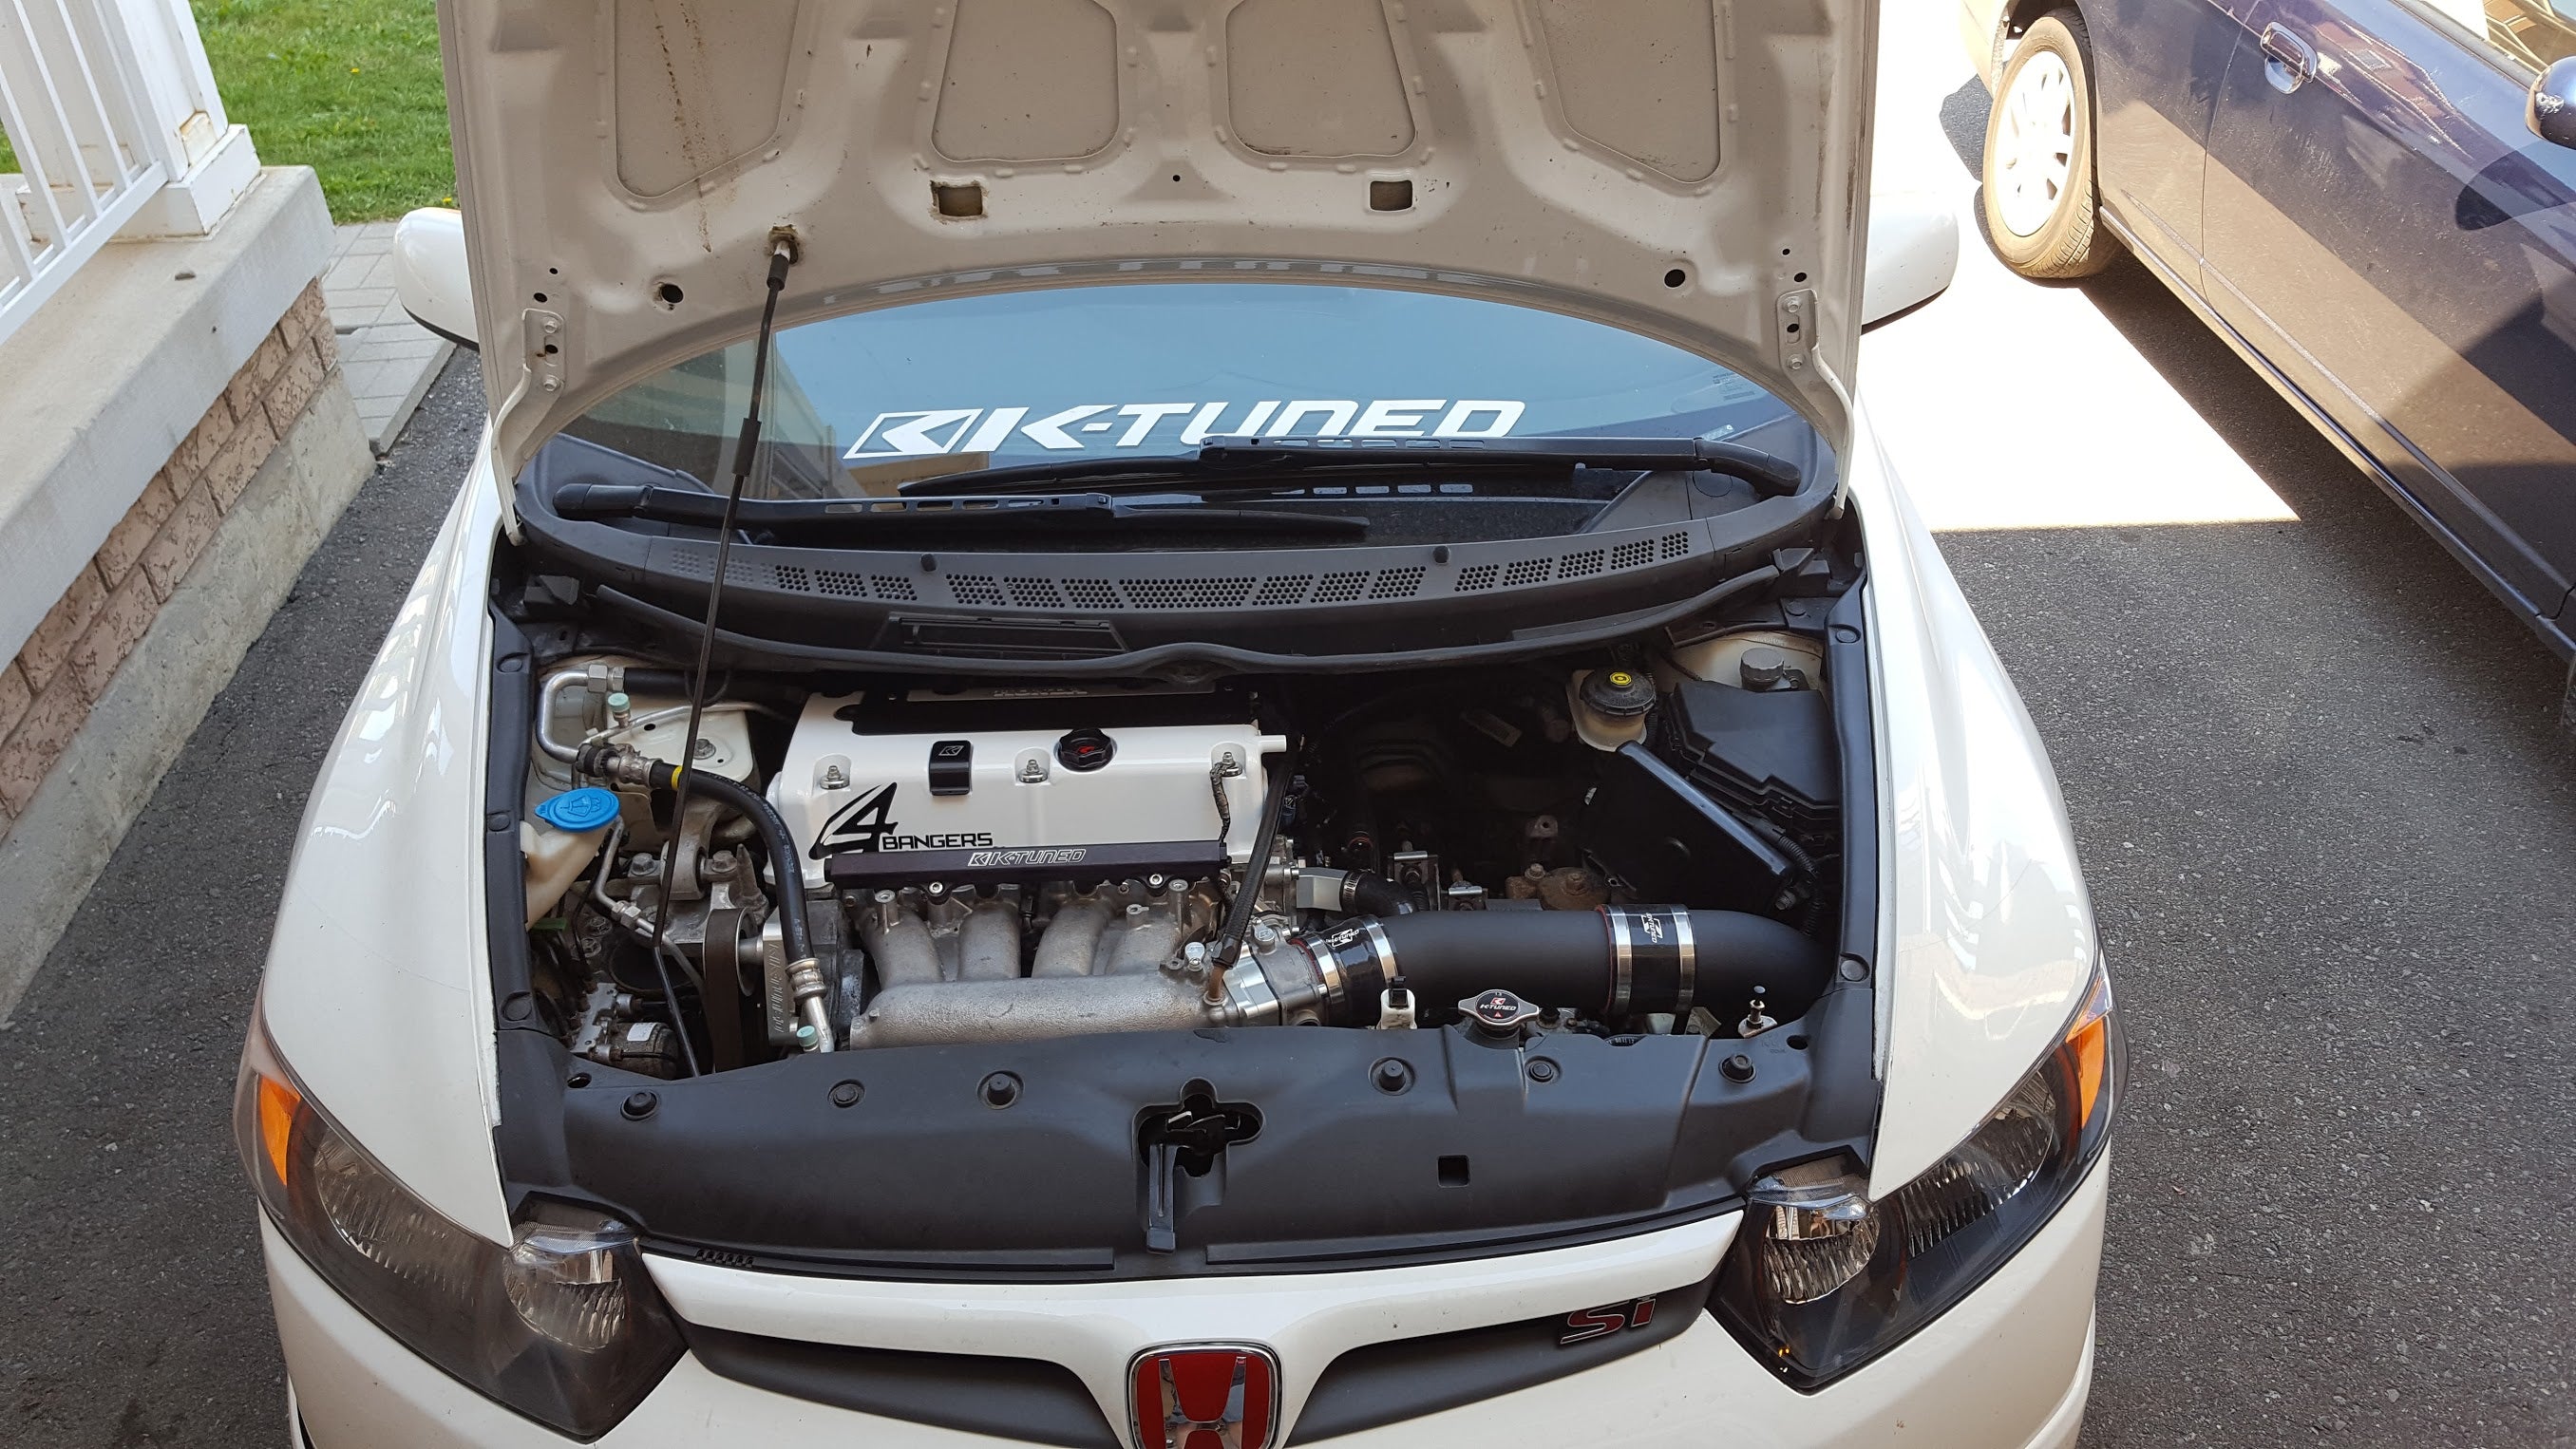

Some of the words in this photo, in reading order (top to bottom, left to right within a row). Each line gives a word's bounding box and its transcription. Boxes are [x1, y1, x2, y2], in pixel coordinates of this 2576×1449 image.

[960, 400, 1525, 452] K-TUNED
[808, 782, 899, 860] 4
[882, 832, 994, 851] BANGERS
[988, 849, 1087, 865] K-TUNED
[1480, 1003, 1517, 1011] K-TUNED
